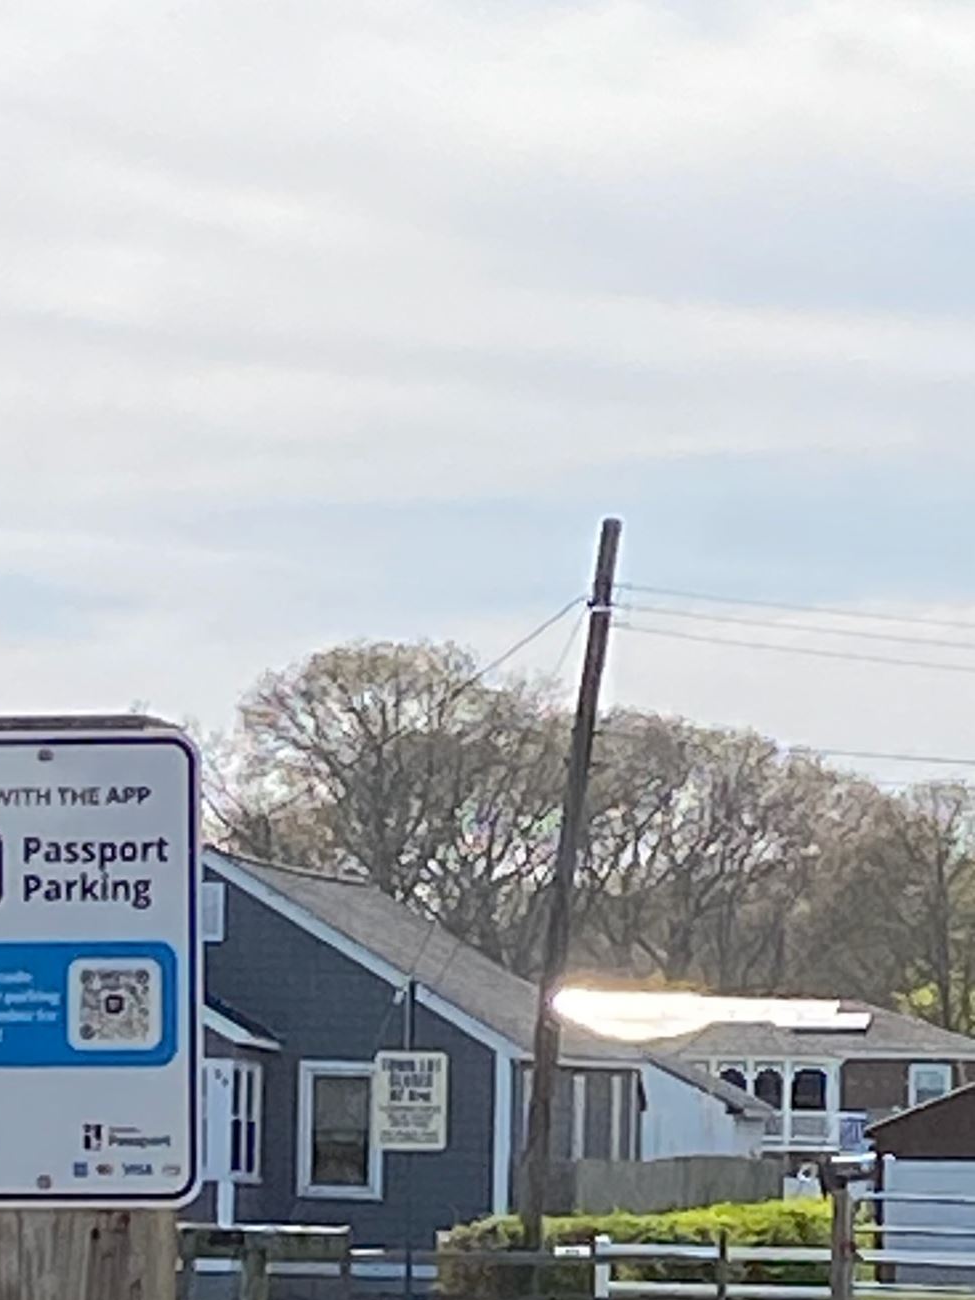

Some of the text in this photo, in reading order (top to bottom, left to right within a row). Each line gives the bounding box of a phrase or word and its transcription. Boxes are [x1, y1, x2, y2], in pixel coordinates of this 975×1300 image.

[58, 786, 100, 806] THE
[105, 786, 151, 804] APP
[23, 837, 169, 870] Passport
[23, 872, 152, 910] Parking
